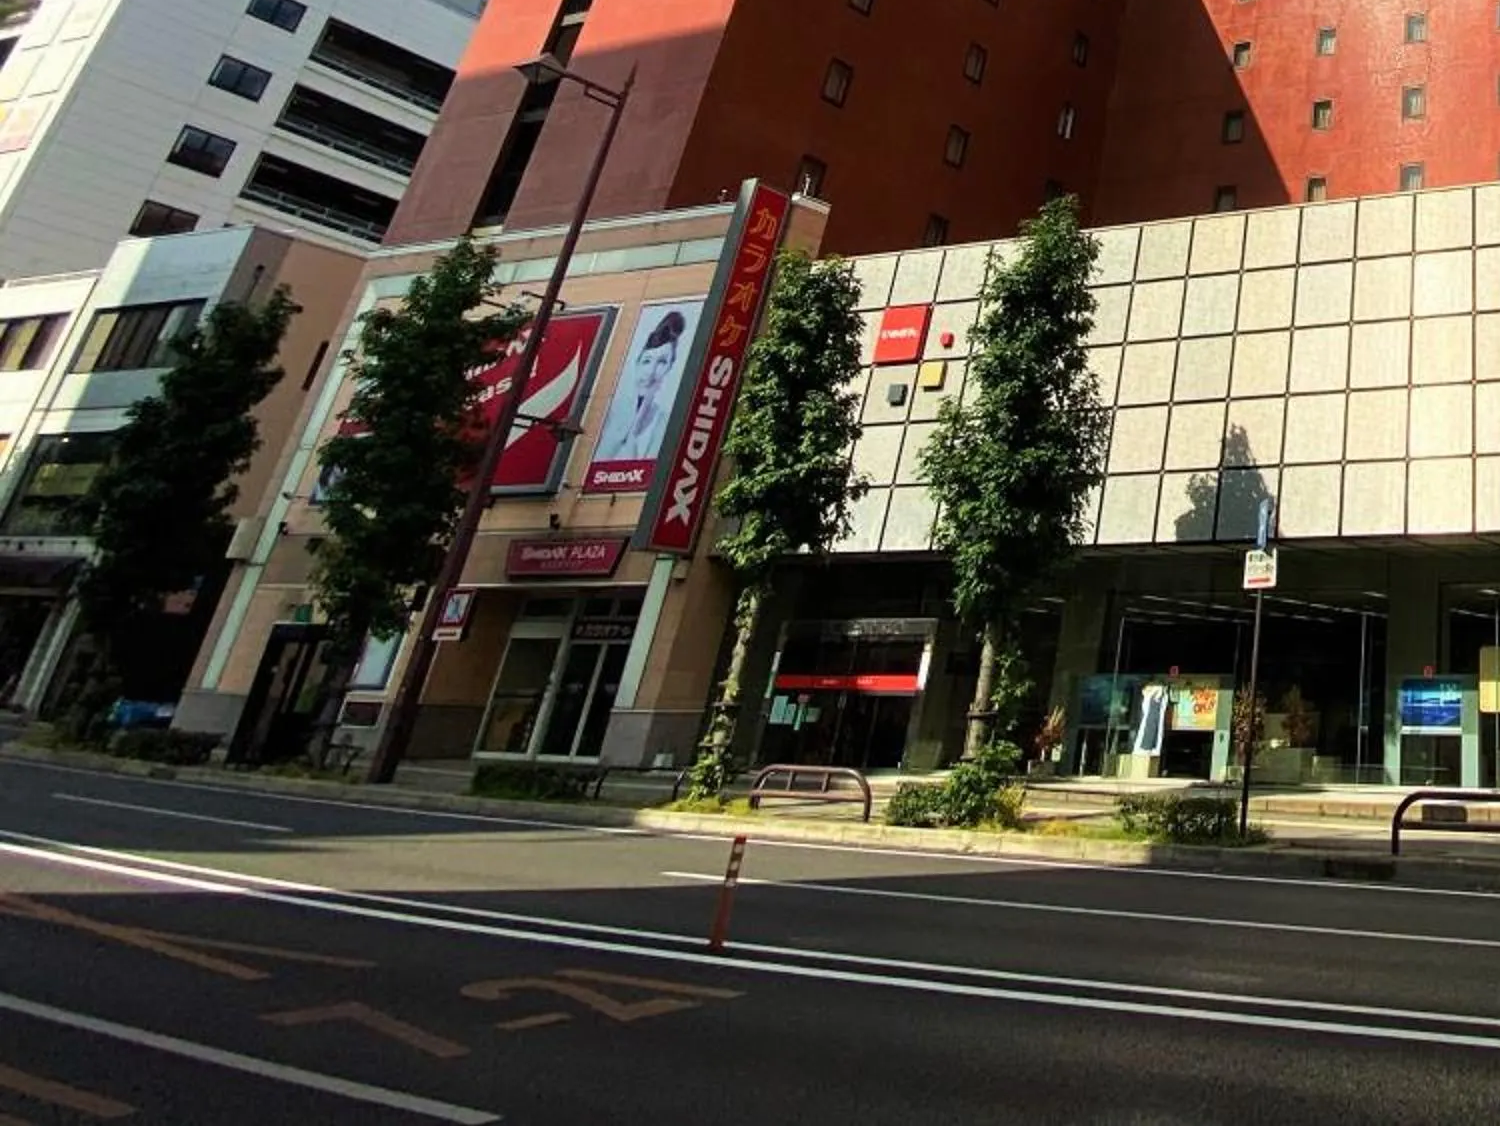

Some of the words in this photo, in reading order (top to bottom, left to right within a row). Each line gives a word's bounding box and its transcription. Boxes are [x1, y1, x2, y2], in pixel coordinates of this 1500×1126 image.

[717, 207, 778, 348] カラオケ
[593, 469, 645, 484] SHIDAX
[665, 355, 735, 526] SHIDAX
[571, 545, 606, 560] PLAZA
